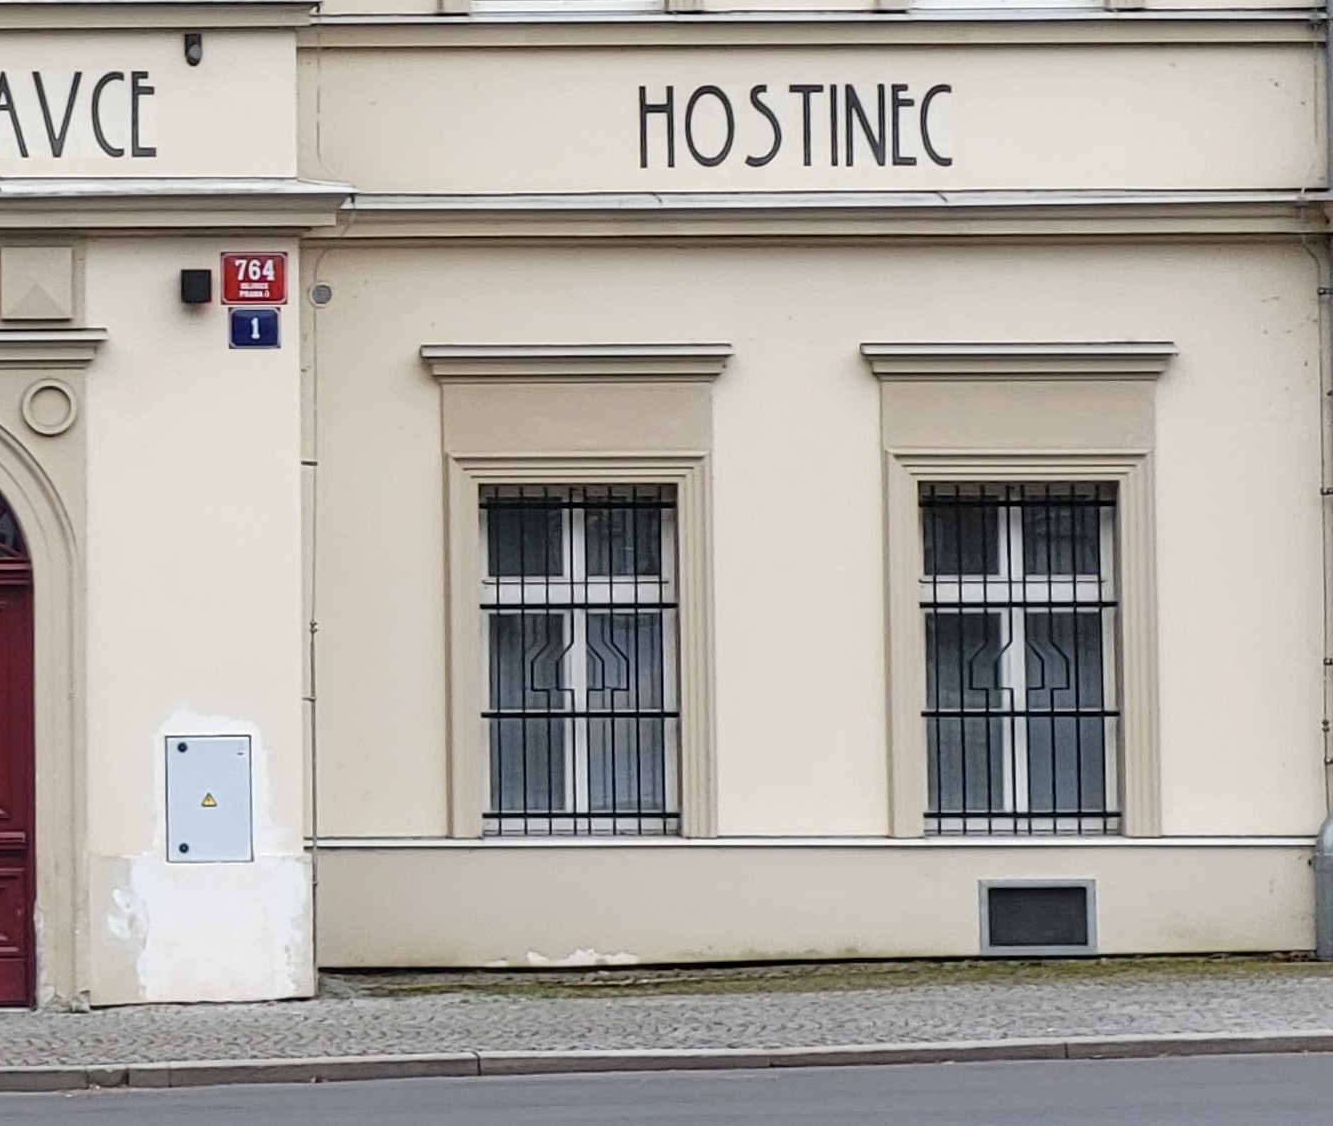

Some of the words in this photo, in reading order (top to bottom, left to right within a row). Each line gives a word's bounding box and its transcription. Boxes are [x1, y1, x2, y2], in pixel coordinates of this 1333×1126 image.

[638, 83, 953, 168] HOSTINEC
[234, 258, 276, 281] 764
[250, 317, 261, 341] 1
